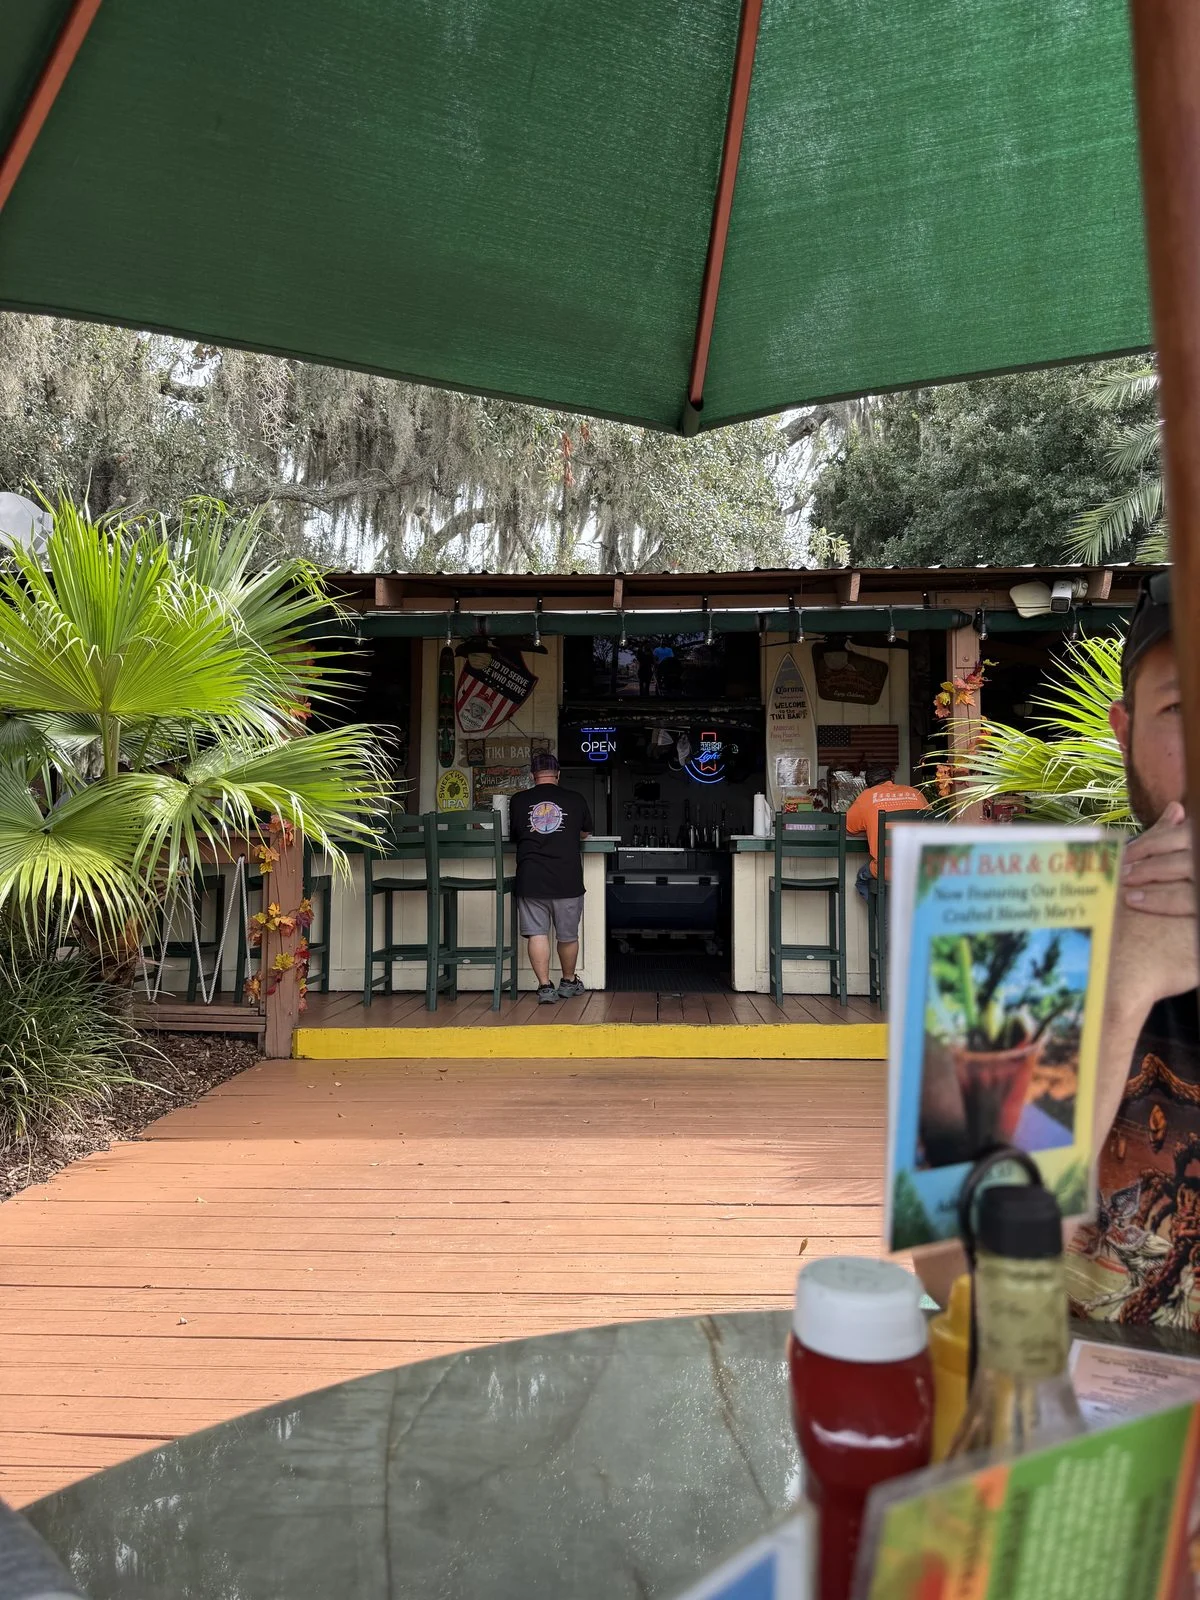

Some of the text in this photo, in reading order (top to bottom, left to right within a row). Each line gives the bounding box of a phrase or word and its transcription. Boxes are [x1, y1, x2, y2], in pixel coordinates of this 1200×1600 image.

[491, 671, 508, 685] WHO
[505, 681, 527, 697] SERVE
[500, 665, 510, 675] TO
[508, 670, 530, 688] SERVE
[774, 701, 807, 710] WELCOME
[486, 746, 531, 760] TIKI BAR
[580, 740, 617, 753] OPEN
[438, 770, 469, 799] SWEETWATER
[442, 799, 465, 809] IPA
[978, 853, 1021, 876] BAR
[1026, 853, 1042, 875] &
[968, 884, 1029, 901] Featuring
[1033, 884, 1056, 896] Our
[1059, 882, 1099, 896] House
[943, 907, 993, 923] Crafted
[1045, 904, 1085, 921] Mary's
